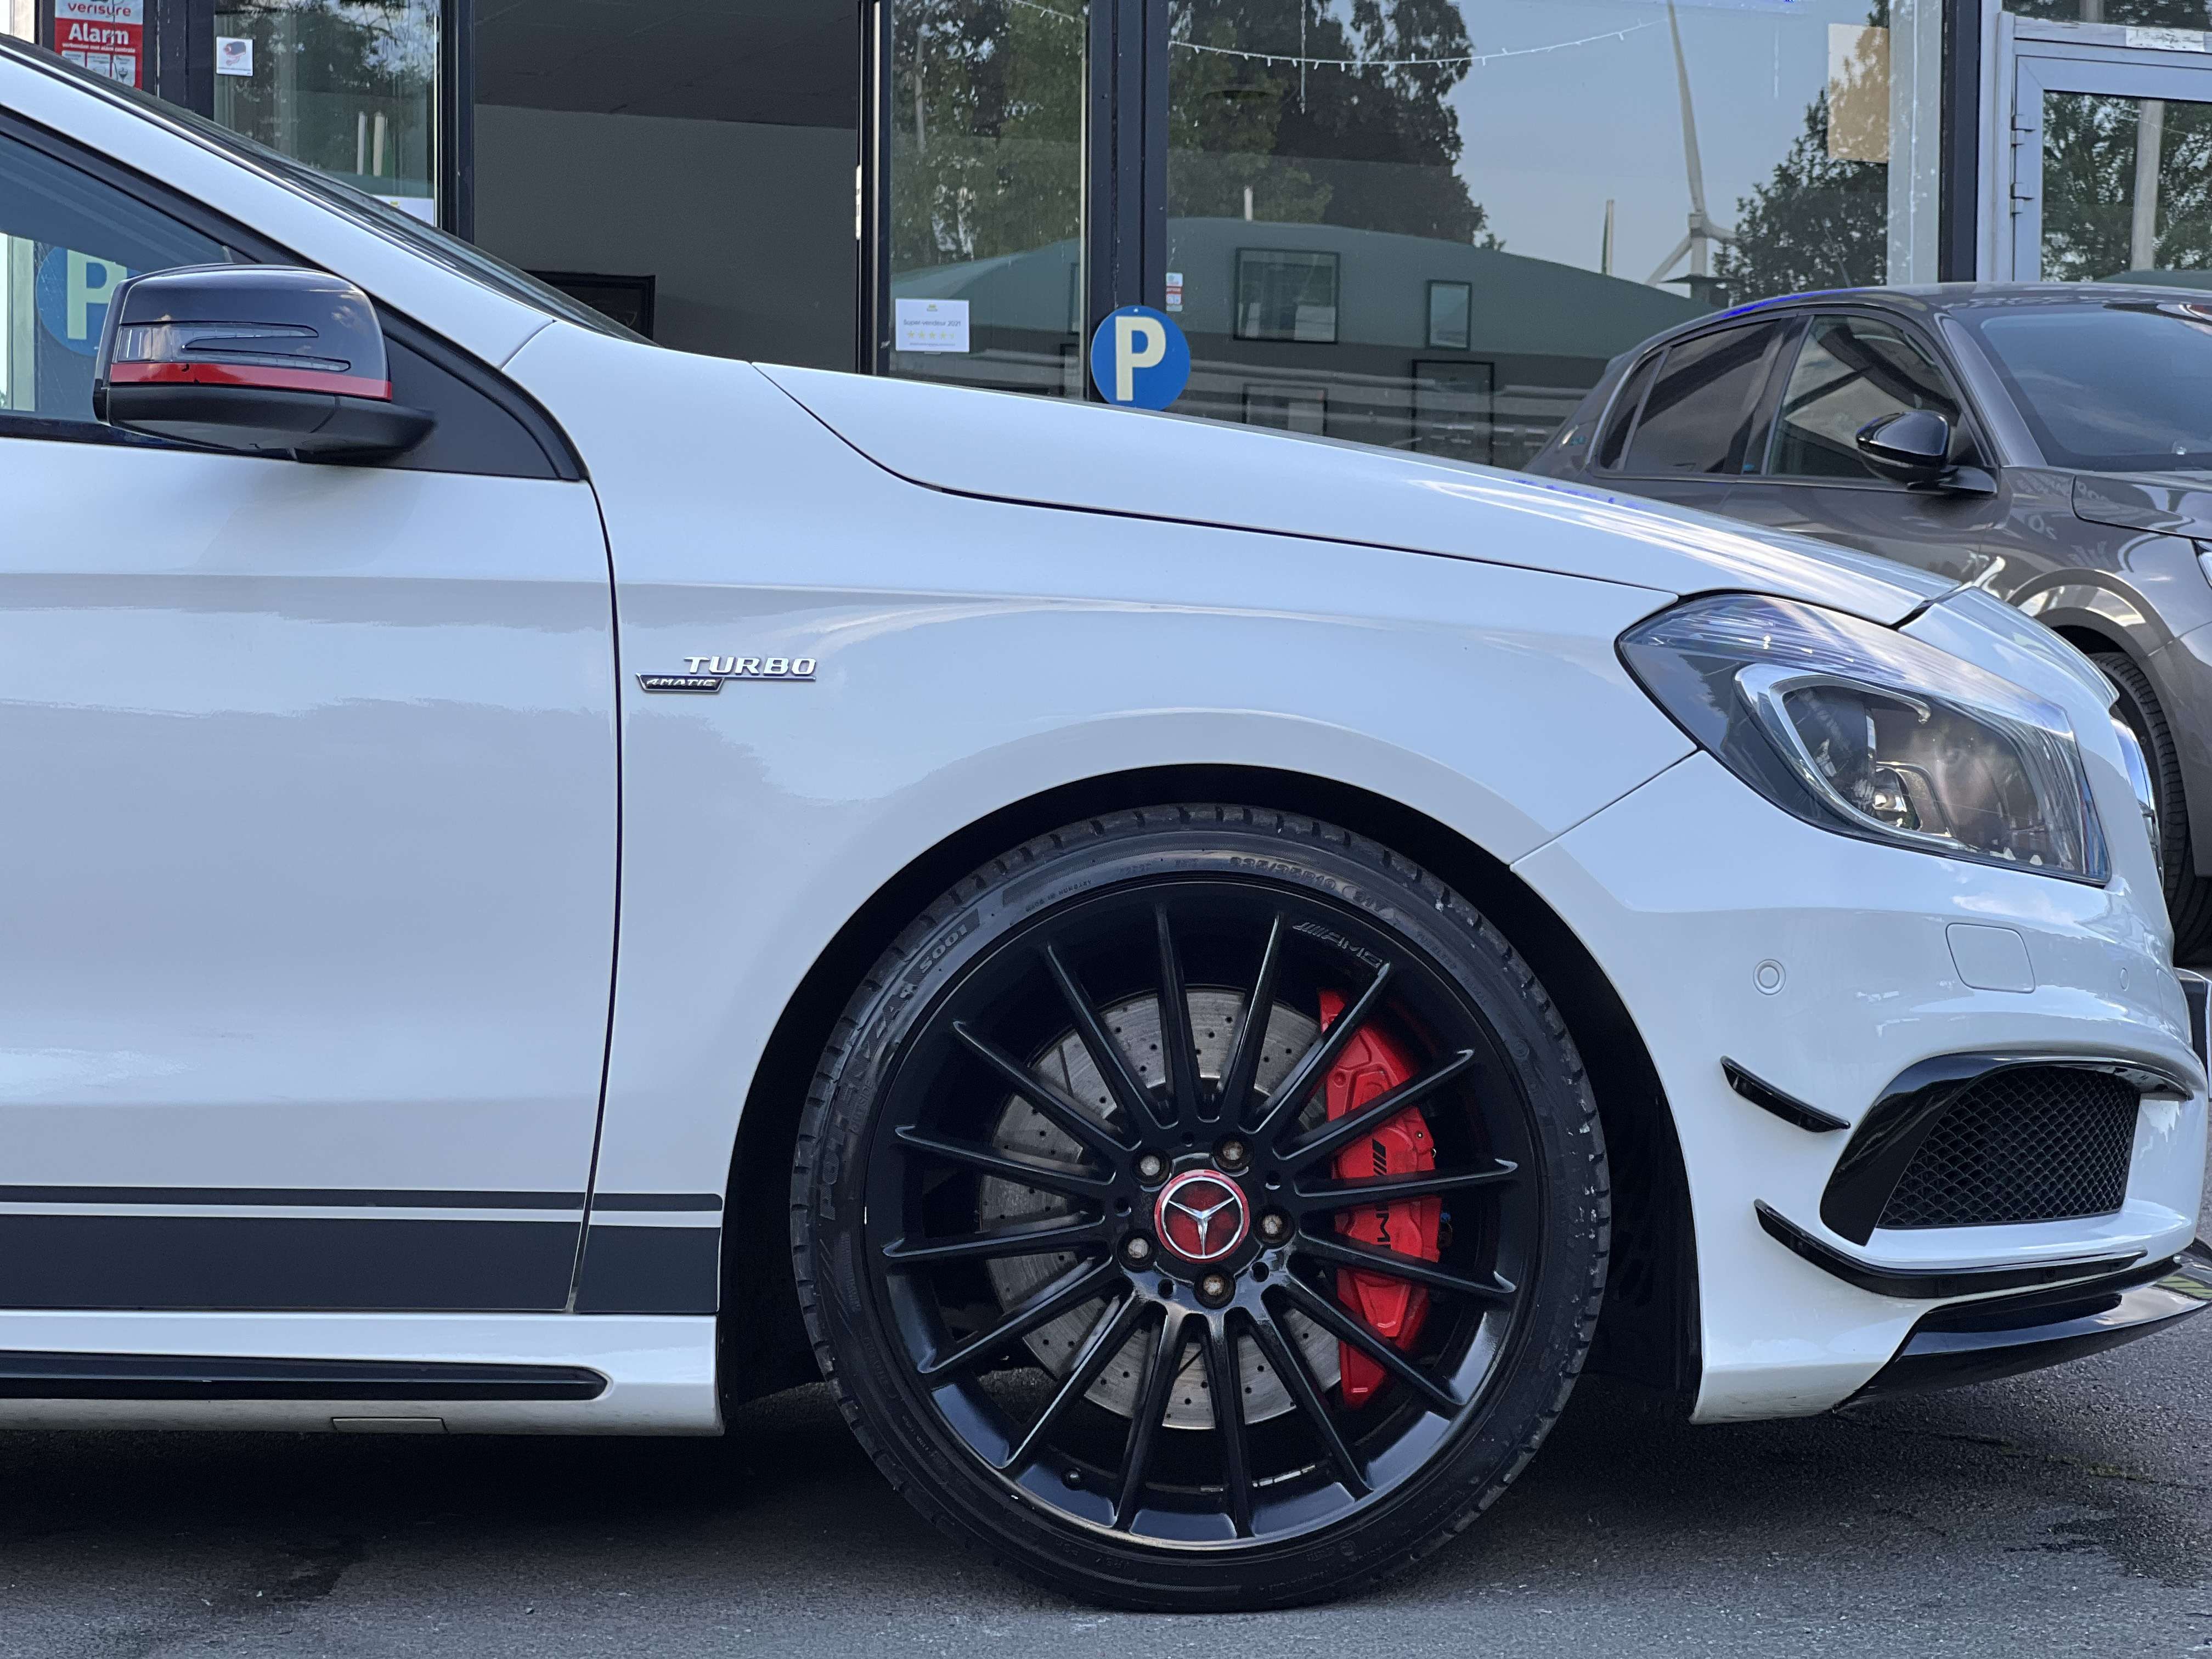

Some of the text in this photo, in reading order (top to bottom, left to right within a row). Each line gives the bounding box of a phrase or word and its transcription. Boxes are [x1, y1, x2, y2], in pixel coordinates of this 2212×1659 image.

[67, 3, 132, 17] verisure
[69, 22, 129, 45] Alarm
[1115, 315, 1166, 402] P
[684, 656, 816, 676] TURBO
[646, 678, 716, 686] 4MATIC
[919, 923, 968, 974] S001
